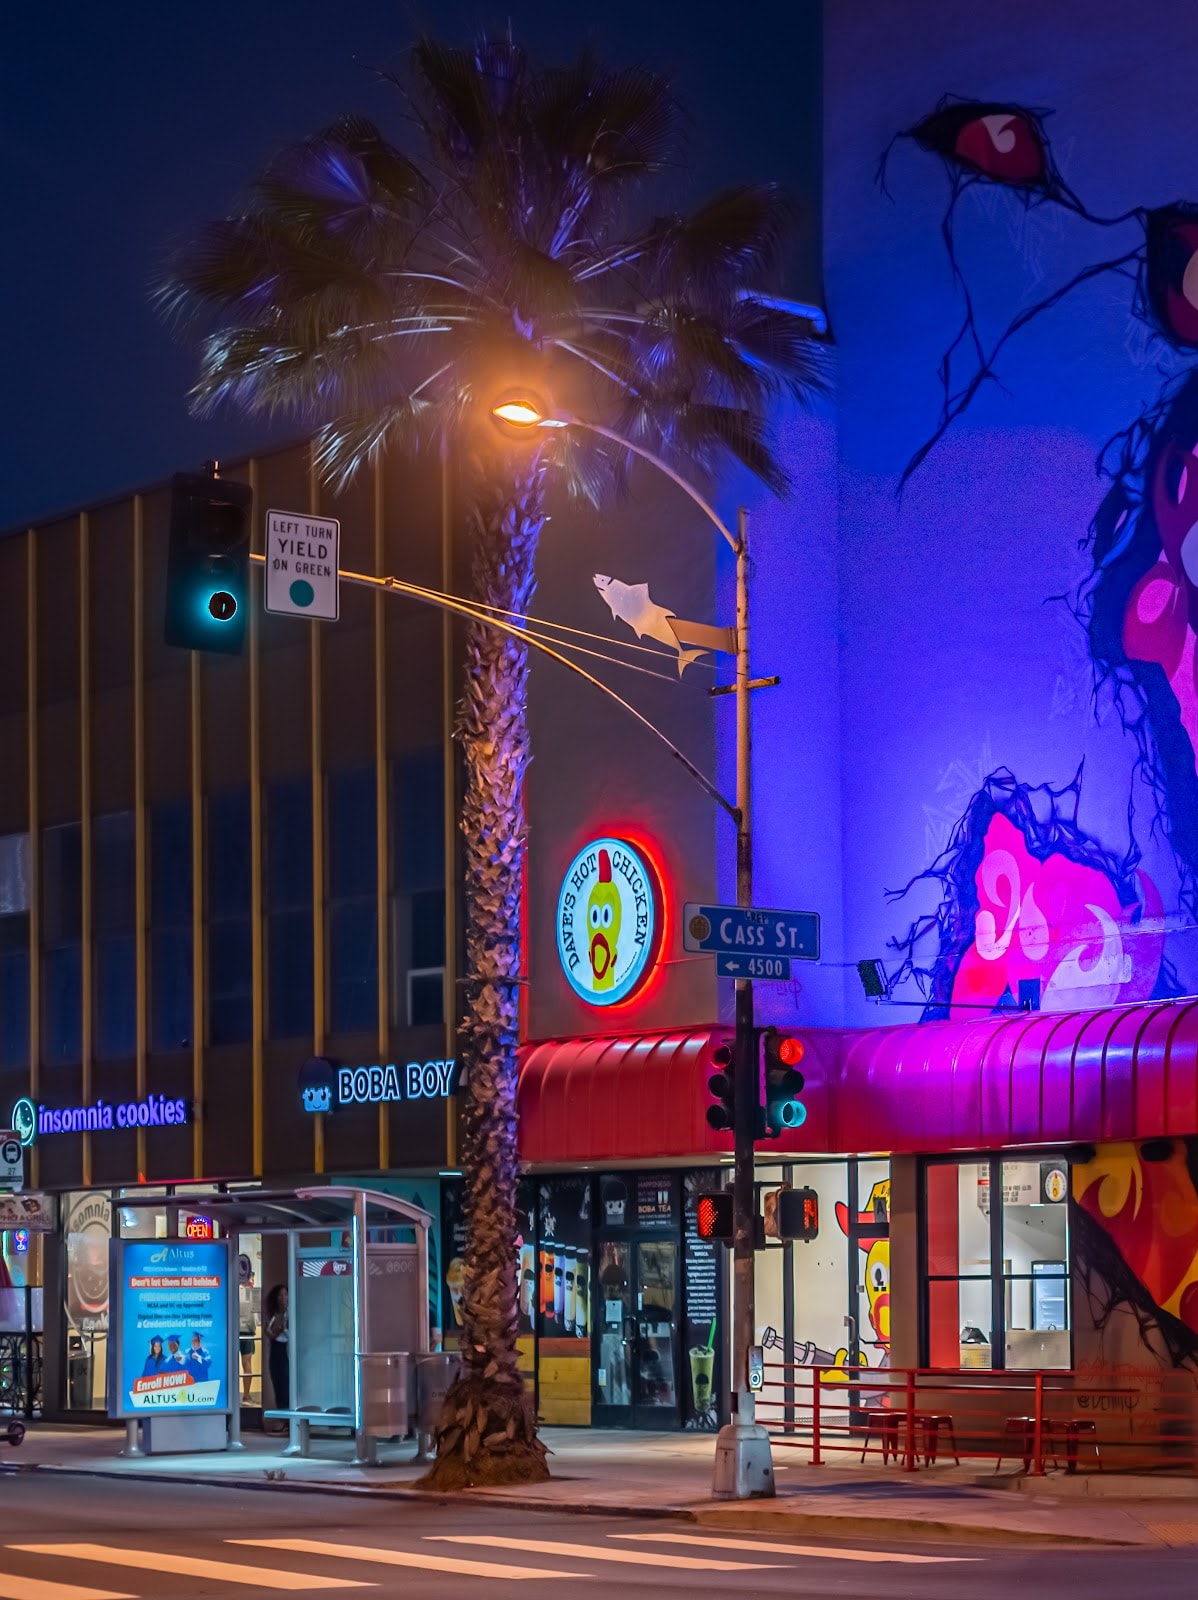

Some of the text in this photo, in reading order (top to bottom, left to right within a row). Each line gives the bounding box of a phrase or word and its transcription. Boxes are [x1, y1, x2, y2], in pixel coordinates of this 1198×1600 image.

[273, 520, 332, 540] LEFT TURN
[278, 538, 328, 559] YIELD
[273, 558, 331, 577] ON GREEN
[571, 852, 597, 892] HOT
[612, 850, 649, 948] CHICKEN
[562, 892, 581, 972] DAVE'S
[748, 958, 783, 976] 4500
[338, 1060, 455, 1104] BOBA BOY
[38, 1093, 187, 1135] insomnia cookies
[8, 1168, 16, 1176] 27
[71, 1202, 111, 1233] somnia
[638, 1204, 671, 1213] BOBA TEA
[187, 1224, 208, 1238] OPEN
[169, 1248, 195, 1259] Altus
[131, 1278, 150, 1287] Don't
[187, 1319, 213, 1327] Teacher
[137, 1373, 187, 1392] Enroll NOW!
